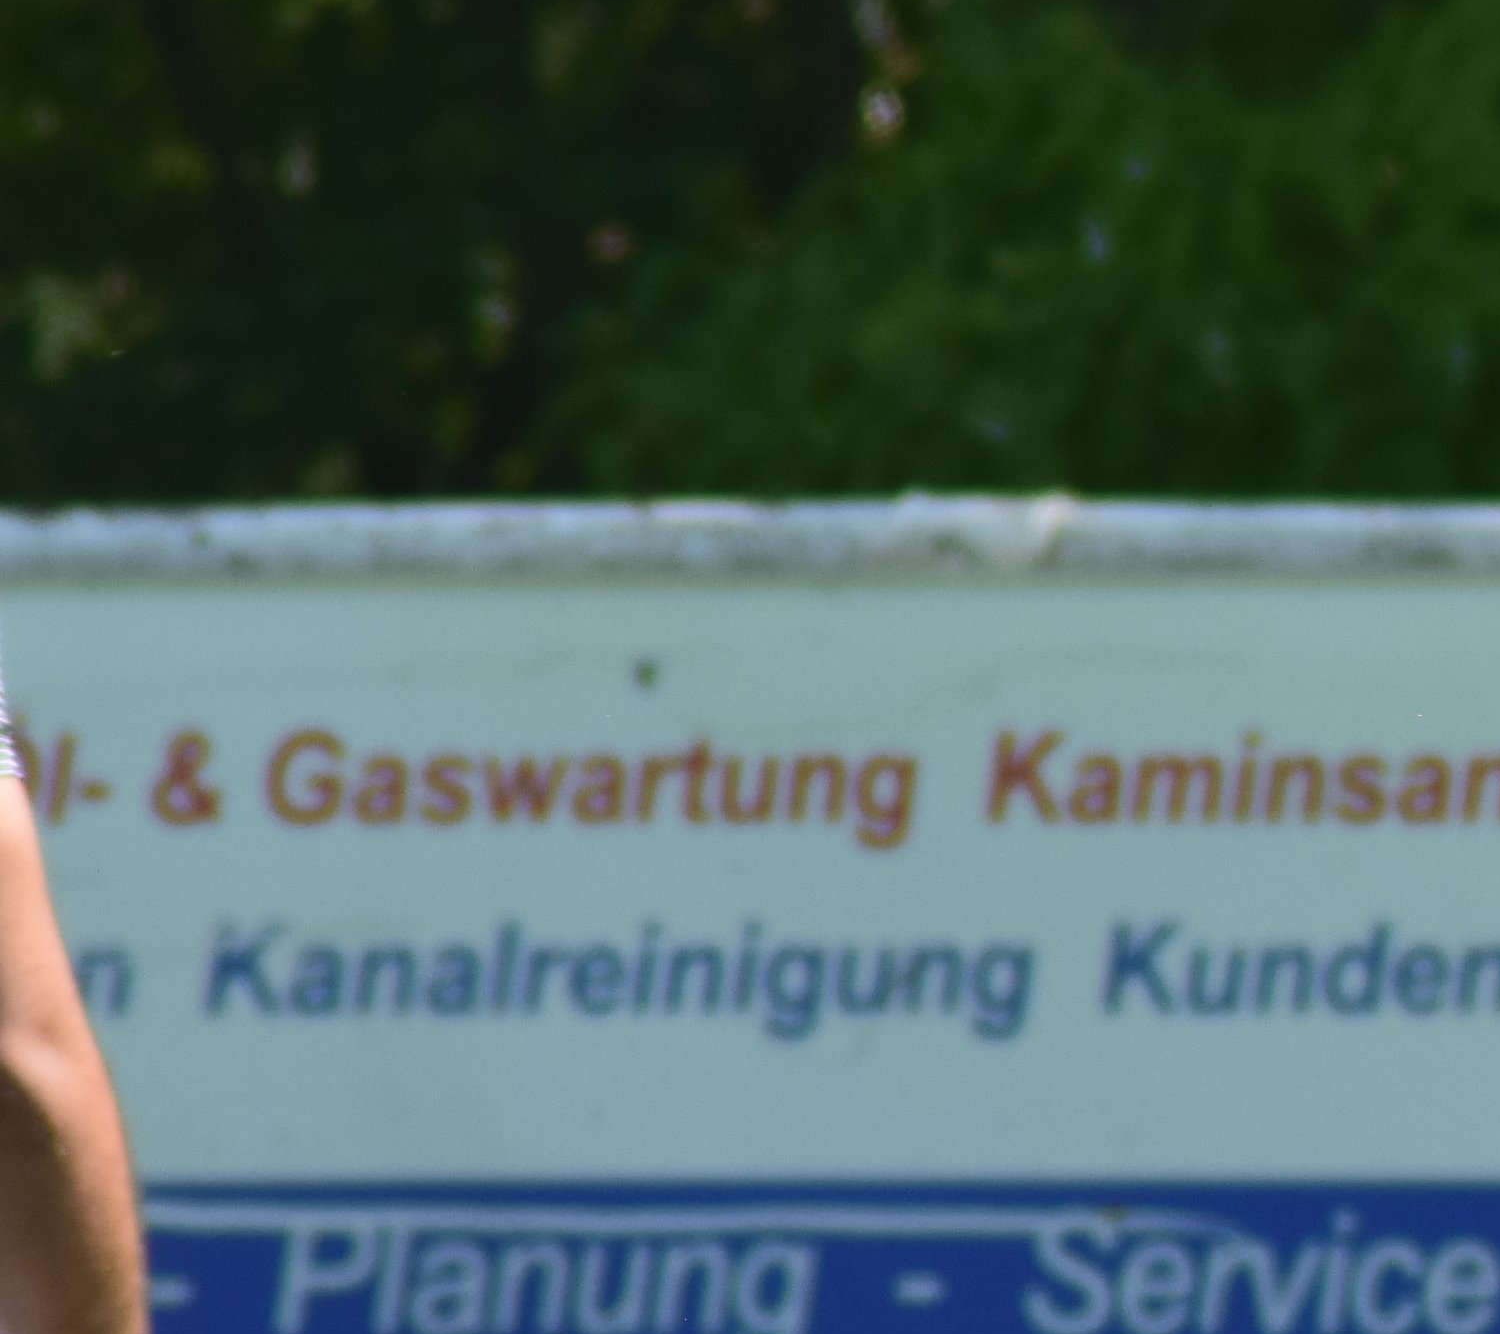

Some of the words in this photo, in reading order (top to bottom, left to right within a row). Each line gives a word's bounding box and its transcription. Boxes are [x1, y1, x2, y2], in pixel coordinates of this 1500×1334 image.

[152, 729, 224, 827] &
[264, 730, 917, 850] Gaswartung
[205, 920, 1035, 1042] Kanalreinigung
